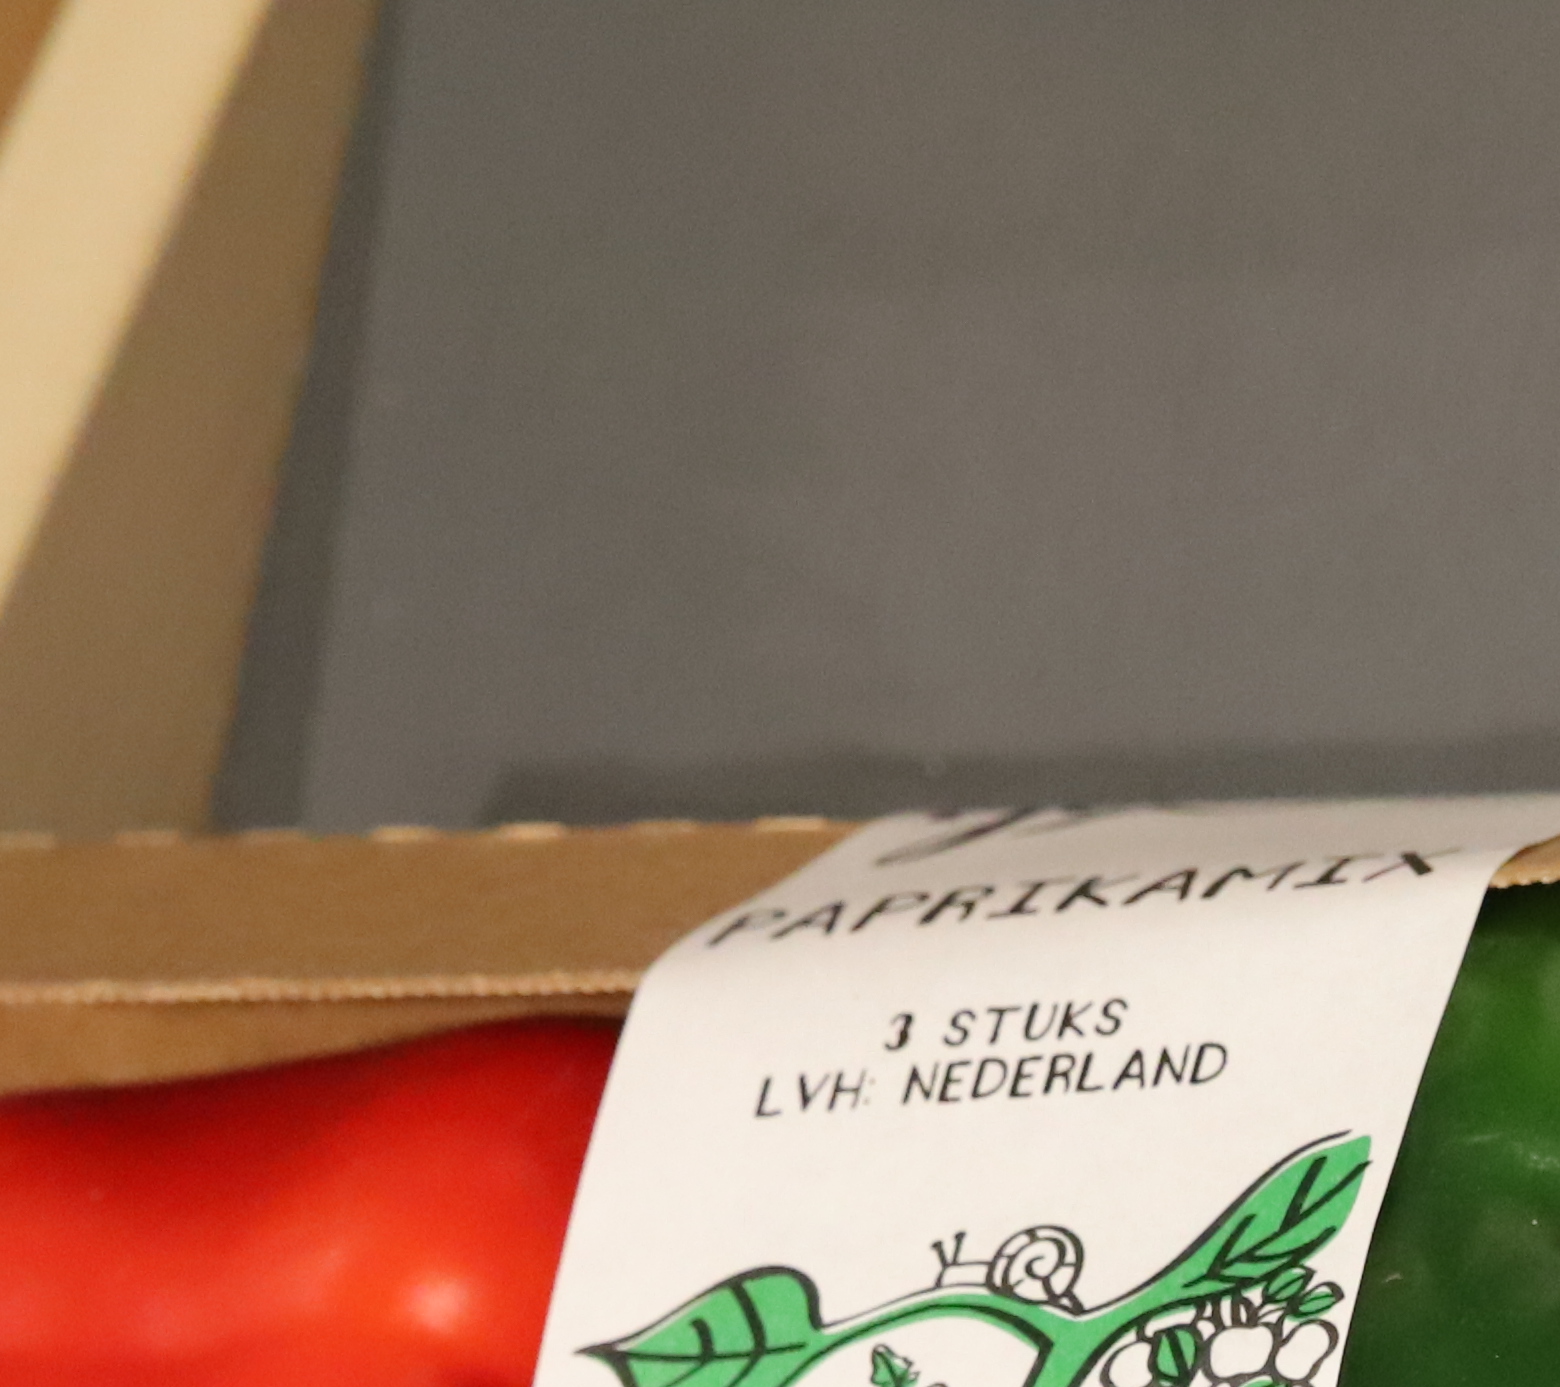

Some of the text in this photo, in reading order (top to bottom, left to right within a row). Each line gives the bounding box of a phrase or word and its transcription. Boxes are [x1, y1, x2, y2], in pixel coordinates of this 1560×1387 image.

[705, 848, 1462, 946] PAPRIKAMIX
[884, 998, 1130, 1052] 3 STUKS
[901, 1042, 1230, 1106] NEDERLAND
